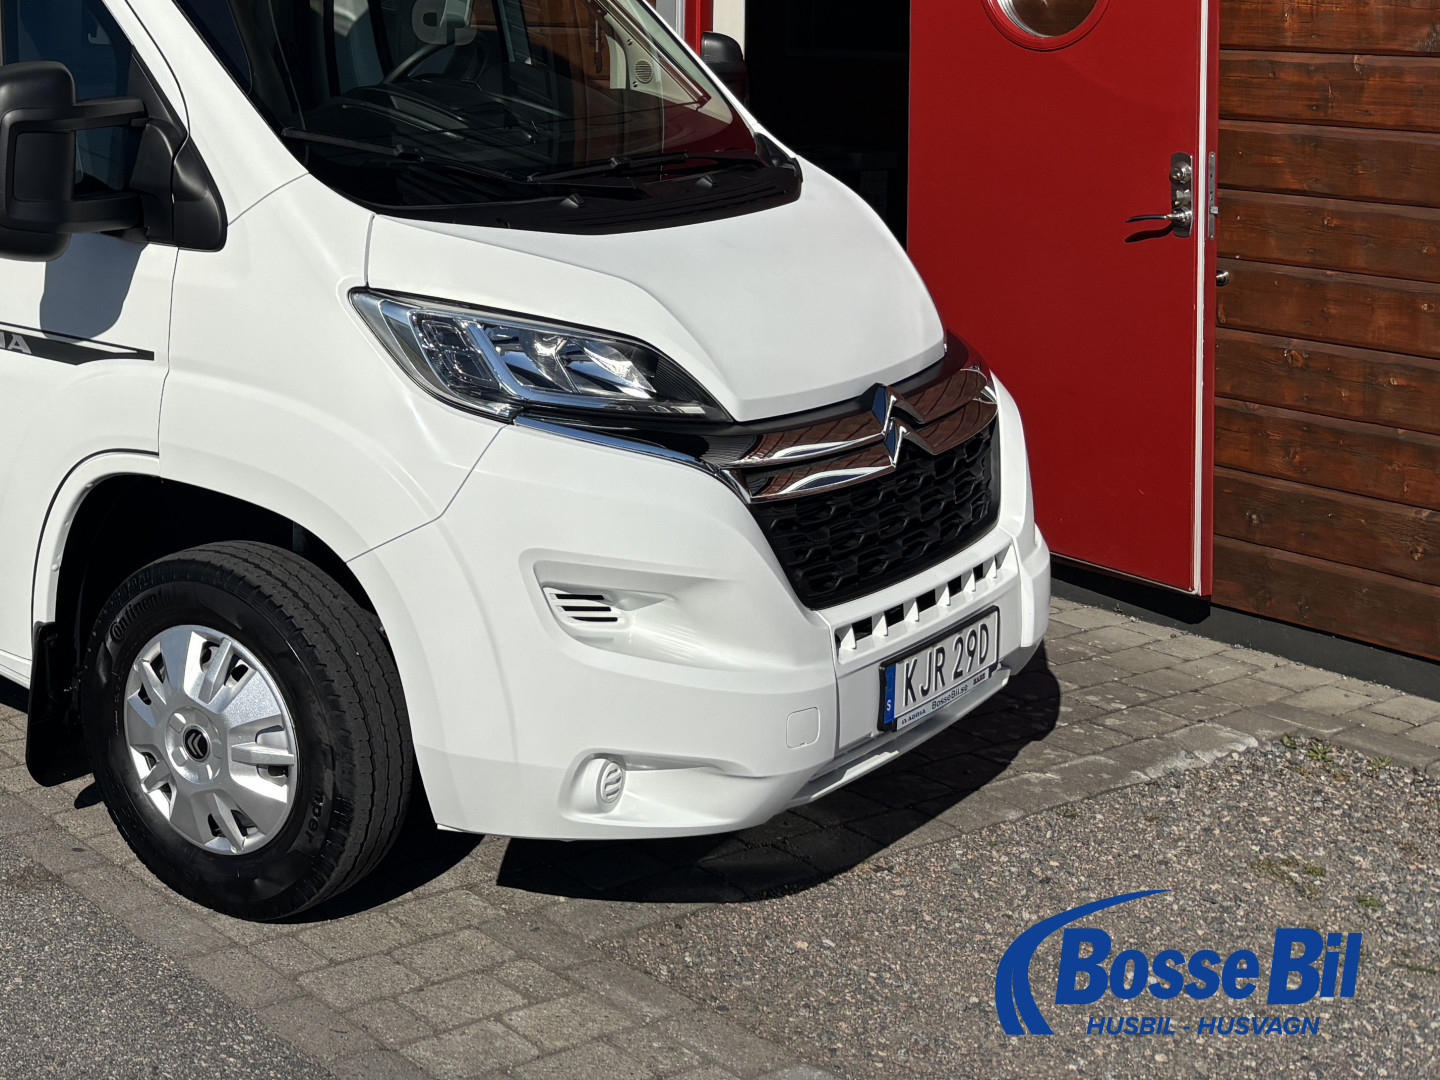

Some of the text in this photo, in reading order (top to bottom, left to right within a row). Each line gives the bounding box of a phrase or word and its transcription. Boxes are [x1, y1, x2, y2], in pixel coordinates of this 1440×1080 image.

[903, 623, 989, 707] KJR 29D
[886, 699, 892, 712] S
